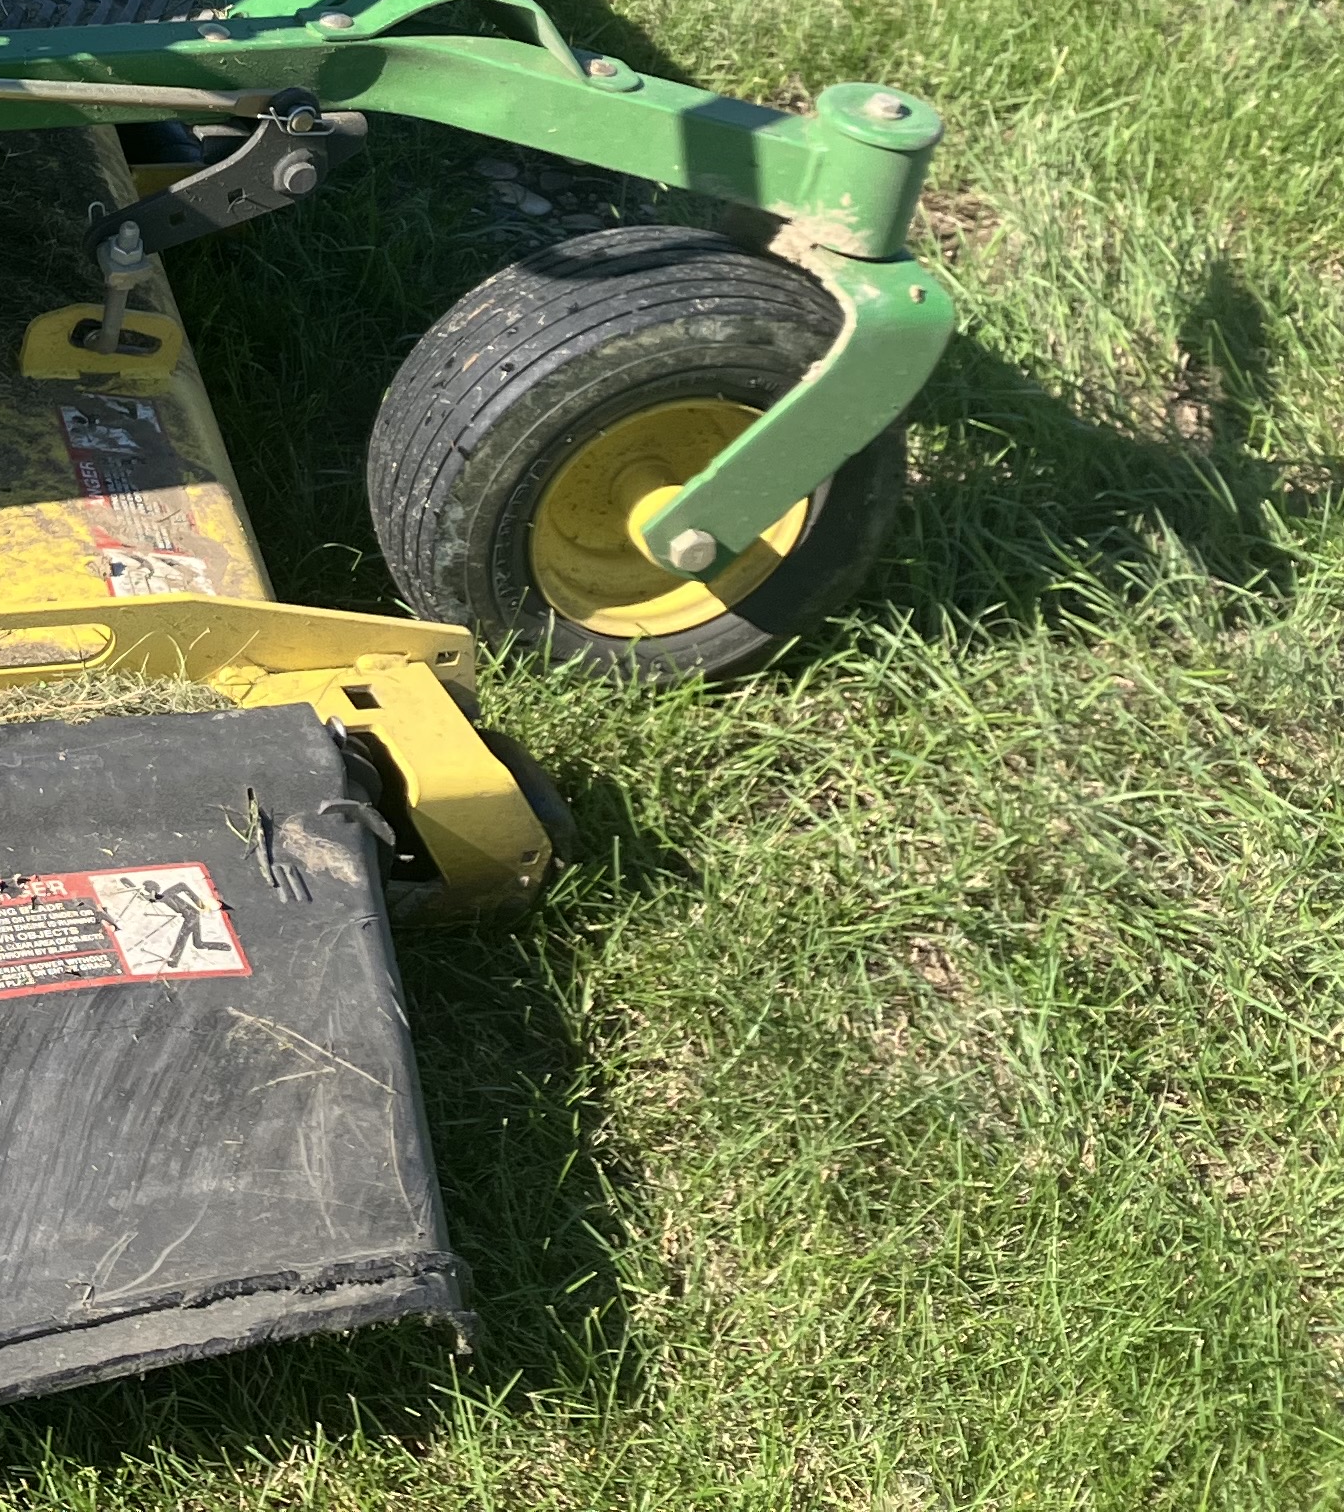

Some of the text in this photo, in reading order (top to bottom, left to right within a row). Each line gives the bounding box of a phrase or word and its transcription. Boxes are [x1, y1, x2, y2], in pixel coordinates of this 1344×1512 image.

[49, 911, 78, 919] UNDER
[14, 922, 47, 931] ENGINE
[16, 927, 79, 940] OBJECTS
[68, 934, 103, 942] OBJECTS
[28, 960, 63, 969] MOWER
[65, 954, 107, 964] WITHOUT
[79, 960, 111, 970] GRASS
